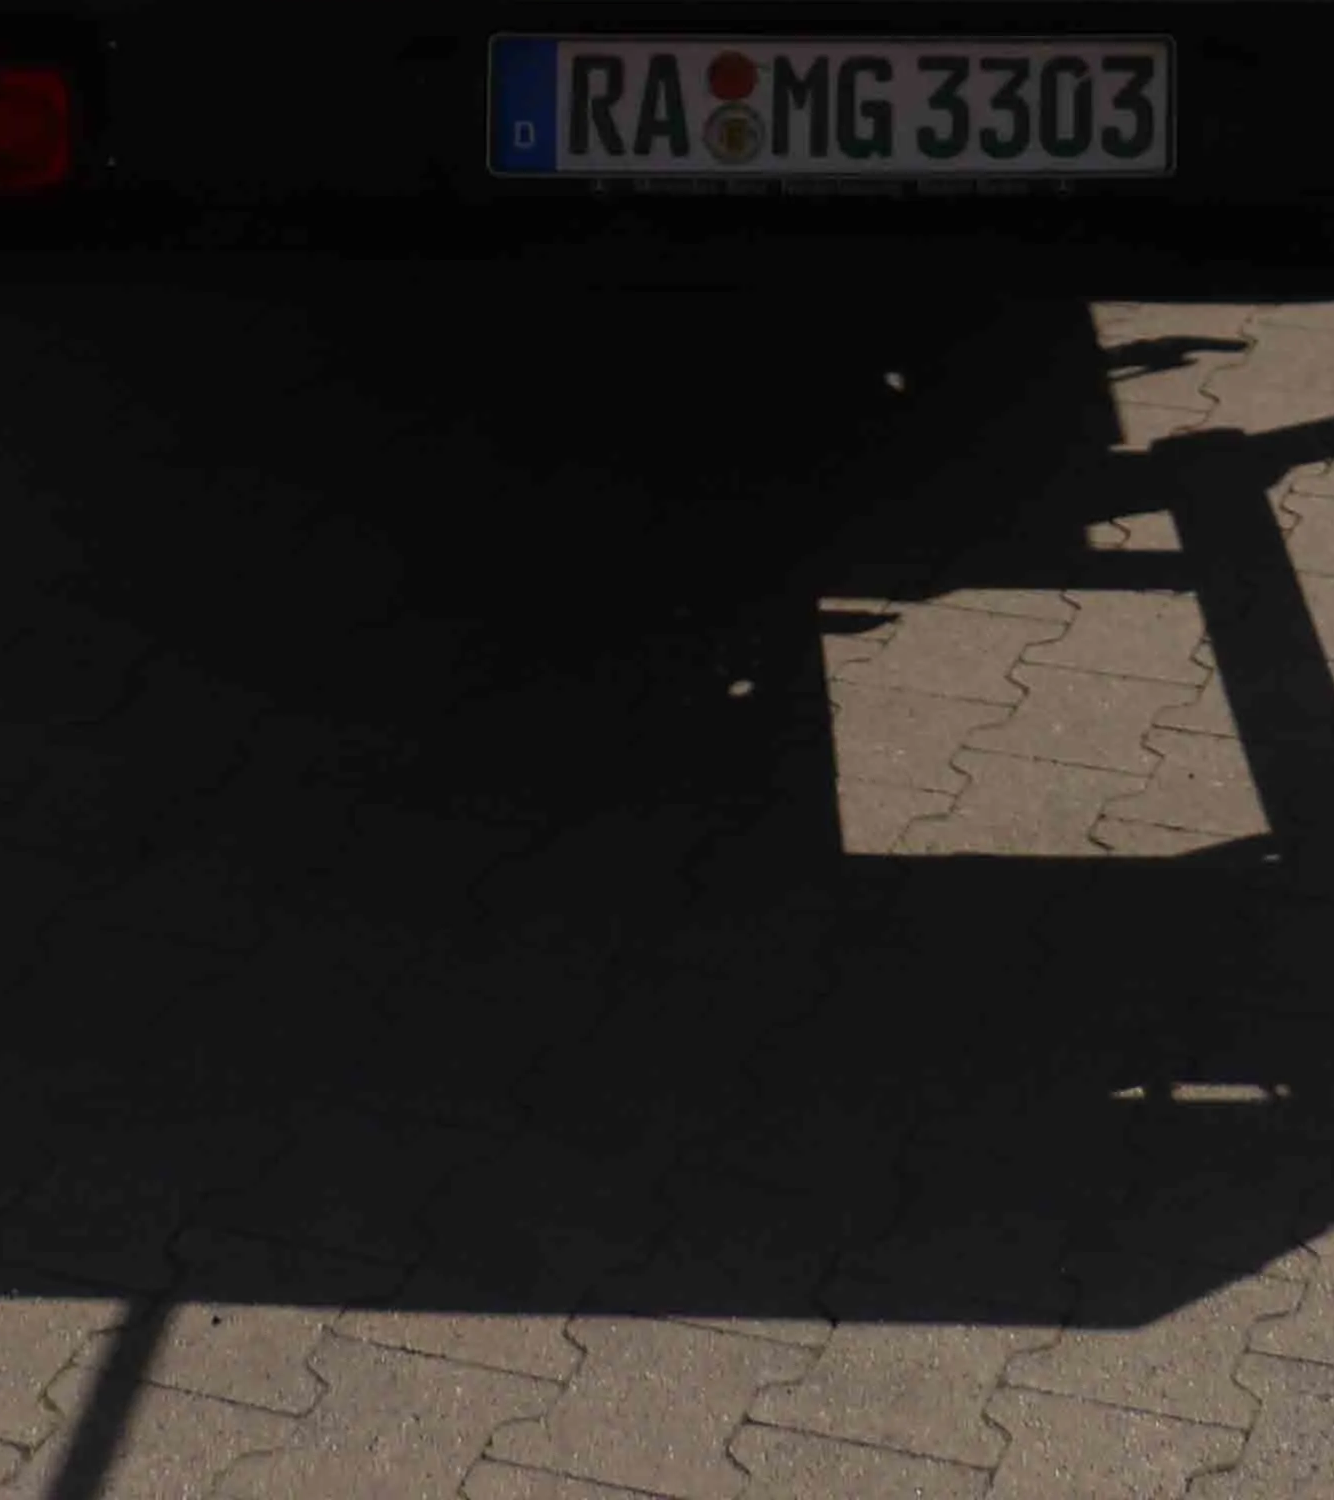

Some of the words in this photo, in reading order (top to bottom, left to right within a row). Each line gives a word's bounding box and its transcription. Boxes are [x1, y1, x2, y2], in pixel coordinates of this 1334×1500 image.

[513, 120, 536, 149] D
[569, 54, 690, 157] RA
[771, 54, 894, 158] MG
[916, 55, 1155, 159] 3303
